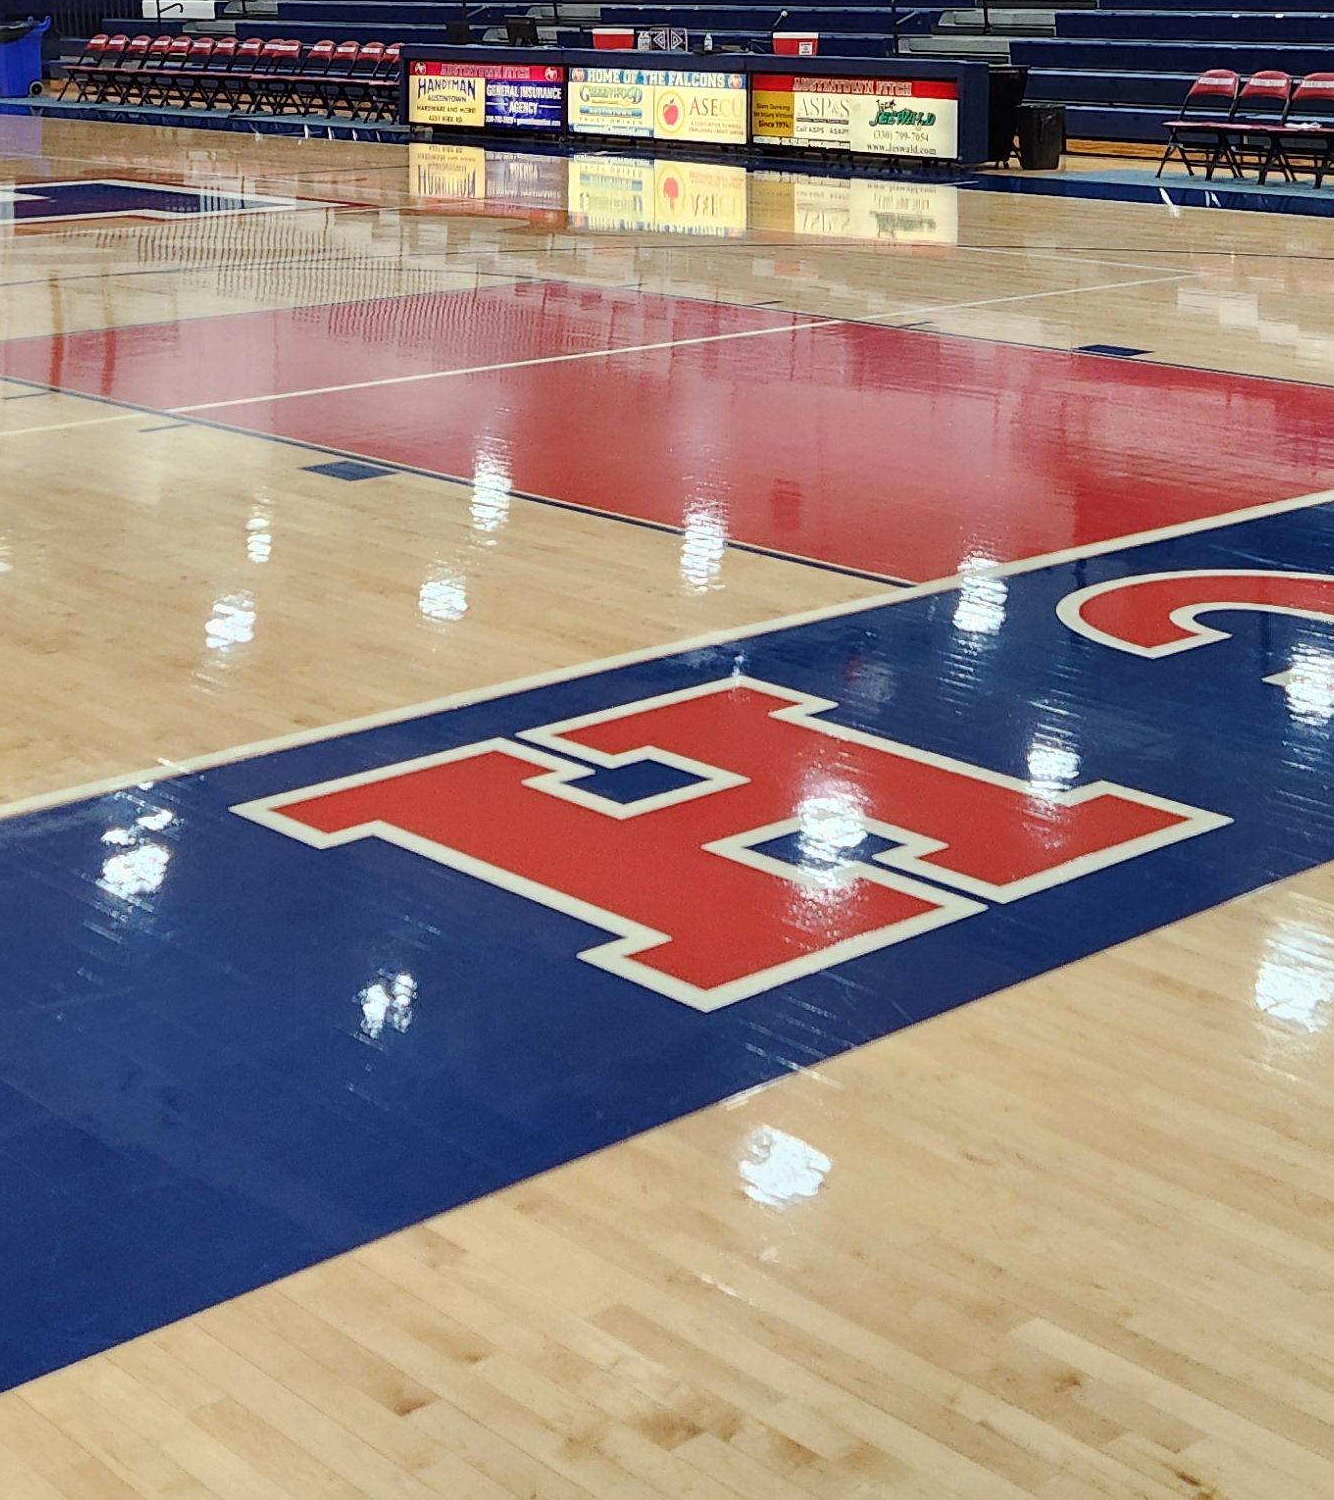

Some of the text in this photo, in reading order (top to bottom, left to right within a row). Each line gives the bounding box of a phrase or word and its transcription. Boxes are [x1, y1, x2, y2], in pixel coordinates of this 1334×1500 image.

[588, 68, 623, 83] HOME
[624, 69, 639, 84] OF
[642, 71, 668, 86] THE
[669, 72, 726, 87] FALCONS
[793, 77, 912, 96] AUSTINTOWN FITCH
[417, 77, 476, 101] HANDYMAN
[486, 84, 562, 99] GENERAL INSURANCE
[509, 101, 539, 115] AGENCY
[689, 96, 744, 116] ASECU
